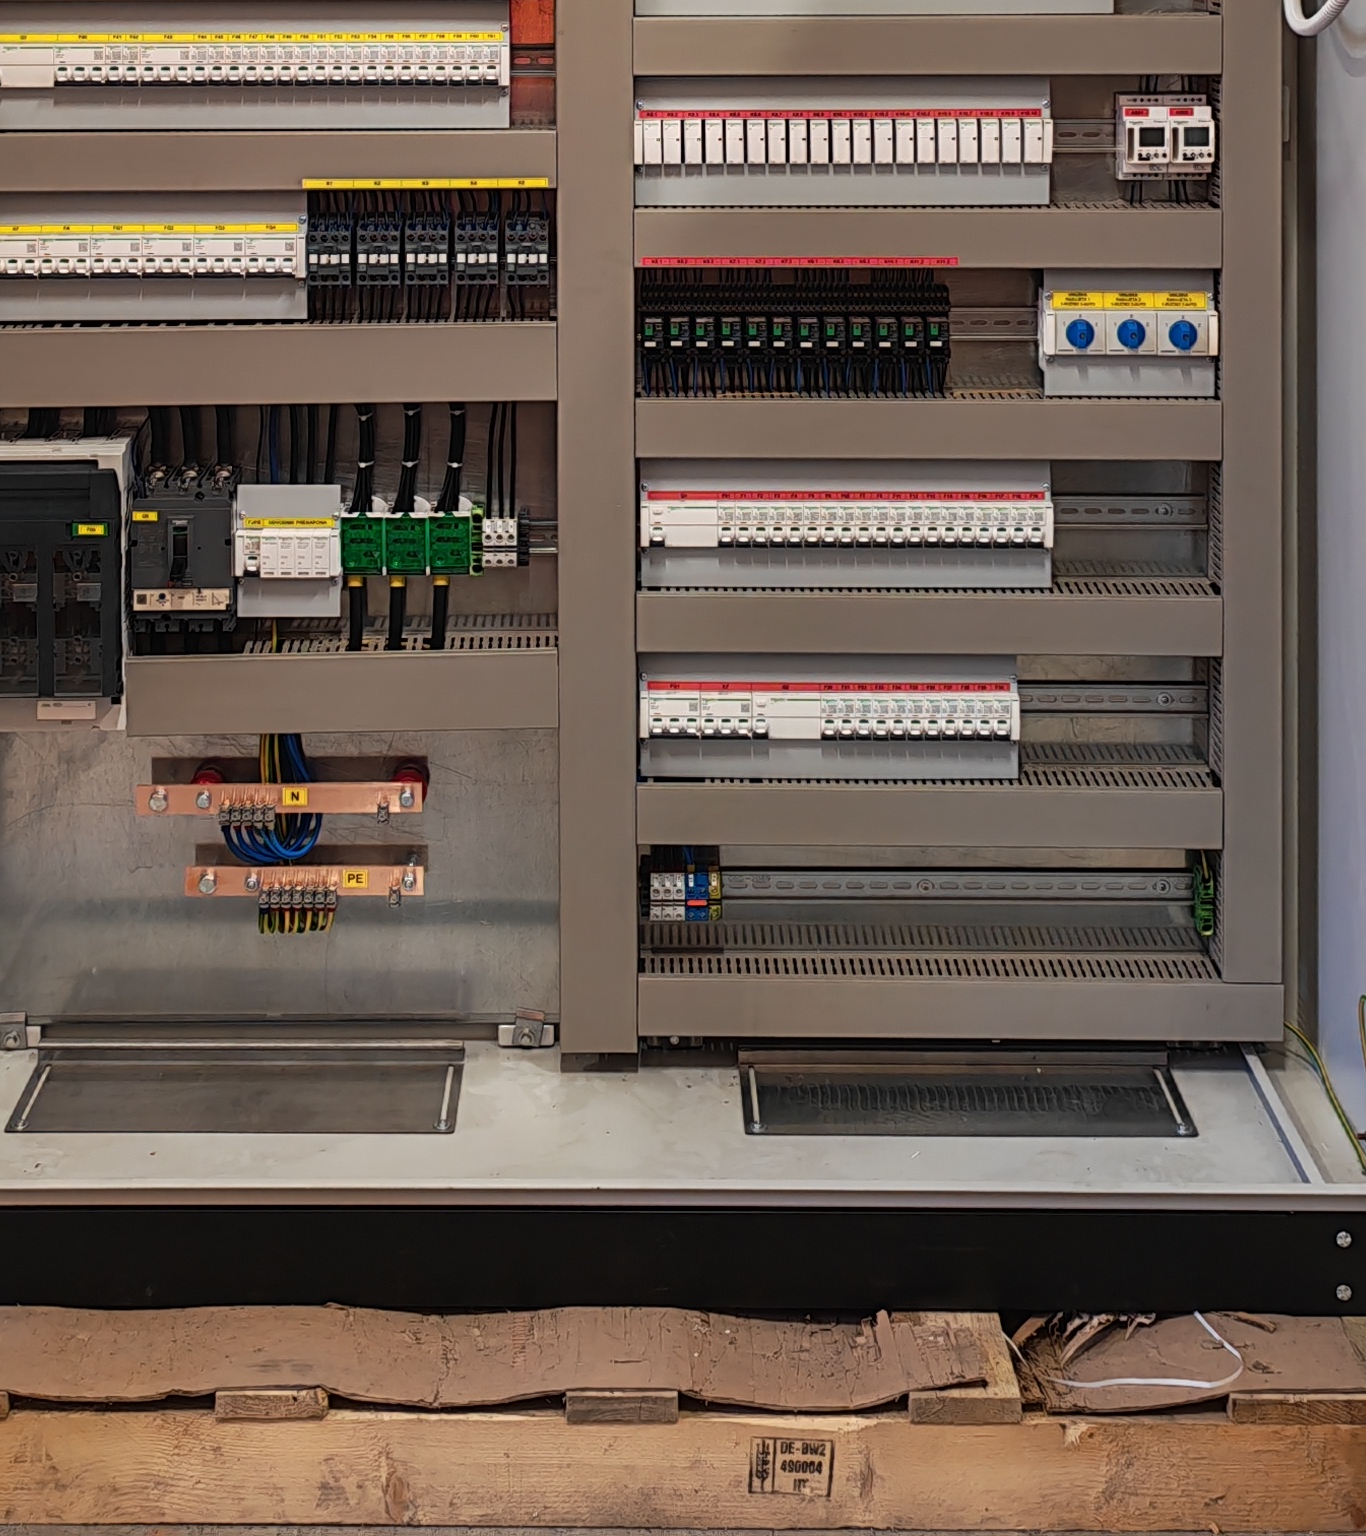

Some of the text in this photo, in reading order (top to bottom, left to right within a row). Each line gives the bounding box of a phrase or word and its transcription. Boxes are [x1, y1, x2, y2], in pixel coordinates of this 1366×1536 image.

[291, 791, 300, 801] N
[347, 873, 364, 884] PE
[780, 1441, 826, 1457] DE-BW2
